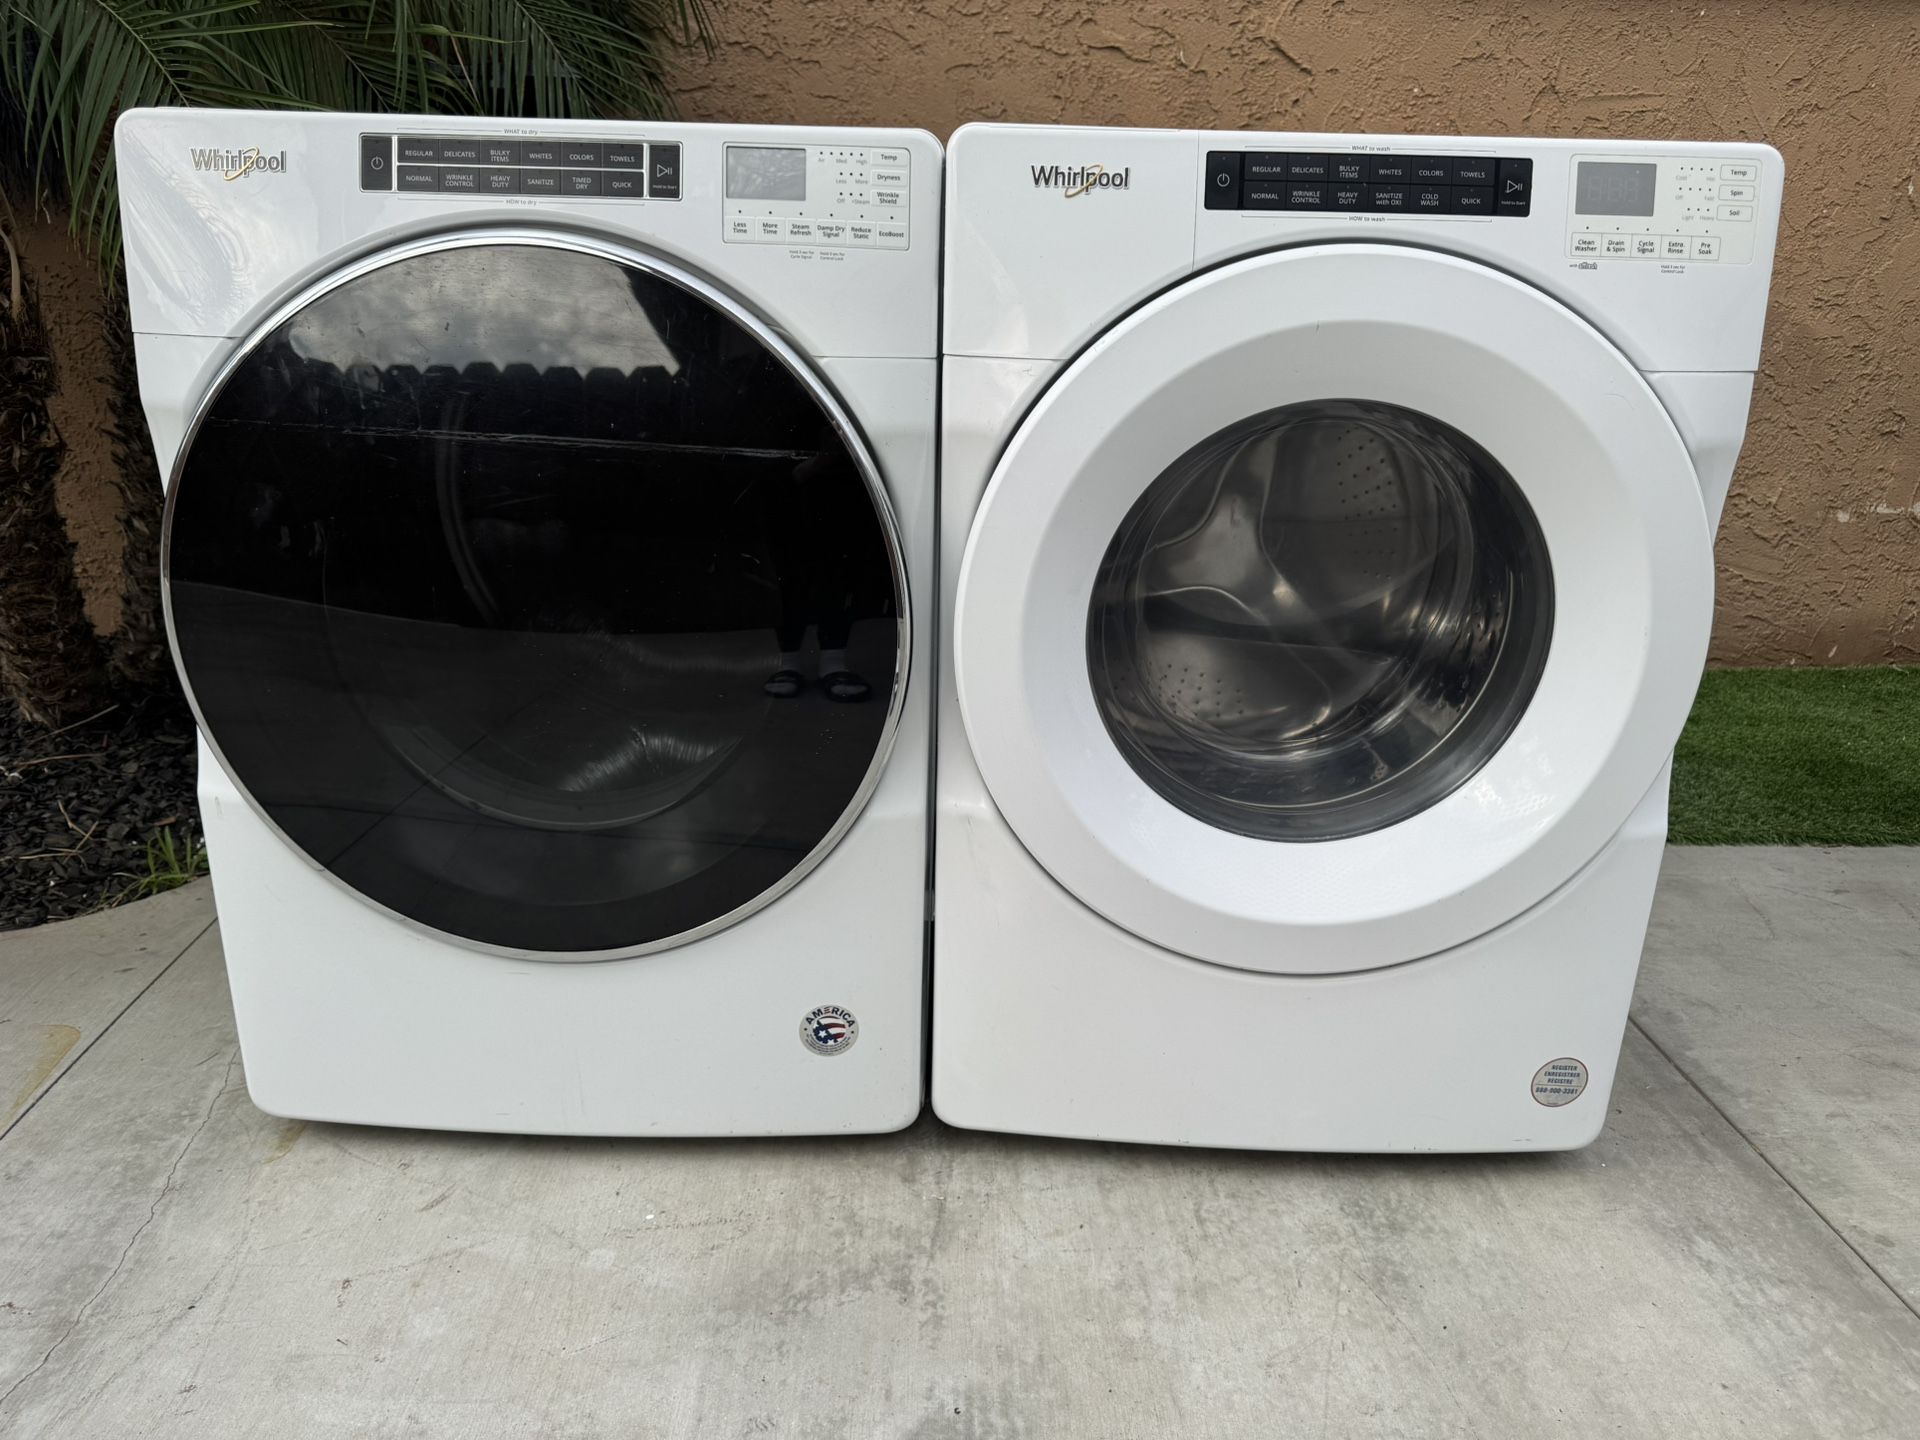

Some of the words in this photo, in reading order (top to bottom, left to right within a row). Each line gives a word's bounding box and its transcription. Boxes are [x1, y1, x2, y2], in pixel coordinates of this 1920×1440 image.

[190, 148, 287, 178] Whirlpool
[610, 155, 635, 163] TOWELS
[1460, 171, 1485, 179] TOWELS
[1730, 169, 1748, 177] Temp
[527, 178, 554, 186] SANITIZE
[877, 174, 901, 182] Dryness
[1031, 165, 1130, 194] Whirlpool
[612, 181, 632, 189] QUICK
[1461, 197, 1481, 205] QUICK
[817, 225, 834, 233] Damp
[835, 225, 846, 233] Dry
[878, 231, 905, 239] EcoBoost
[1638, 240, 1654, 248] Cycle
[1637, 246, 1655, 254] Signal
[805, 1006, 856, 1028] AMERICA
